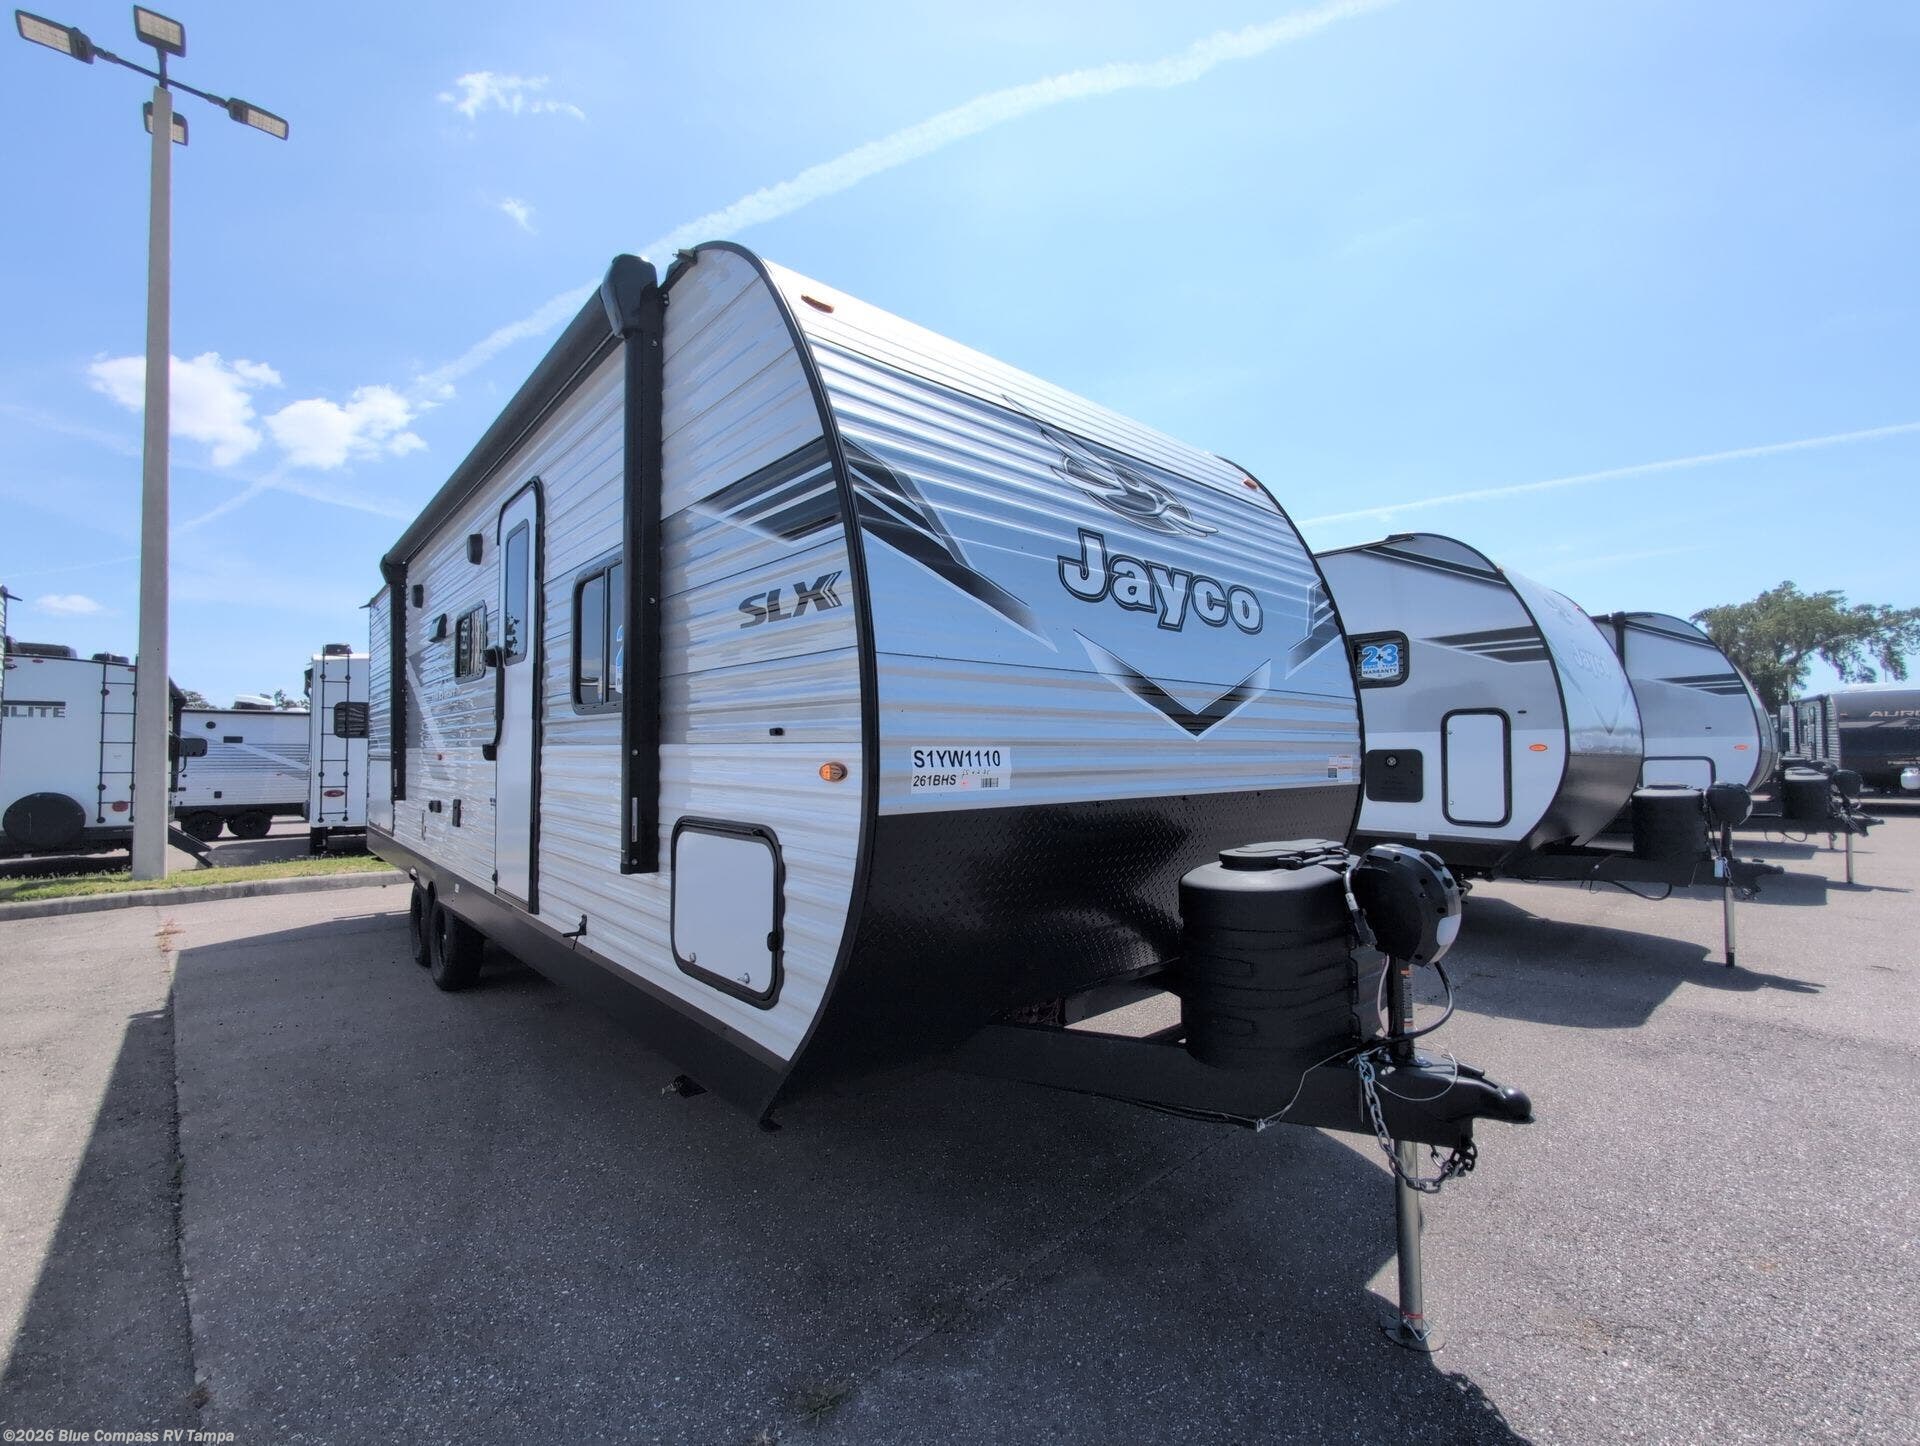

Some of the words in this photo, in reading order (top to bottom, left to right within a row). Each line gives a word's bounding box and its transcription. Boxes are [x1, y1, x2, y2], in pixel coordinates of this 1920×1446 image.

[738, 570, 843, 629] SLX
[1057, 527, 1264, 635] Jayco
[913, 750, 1001, 768] S1YW1110
[913, 774, 957, 787] 261BHS
